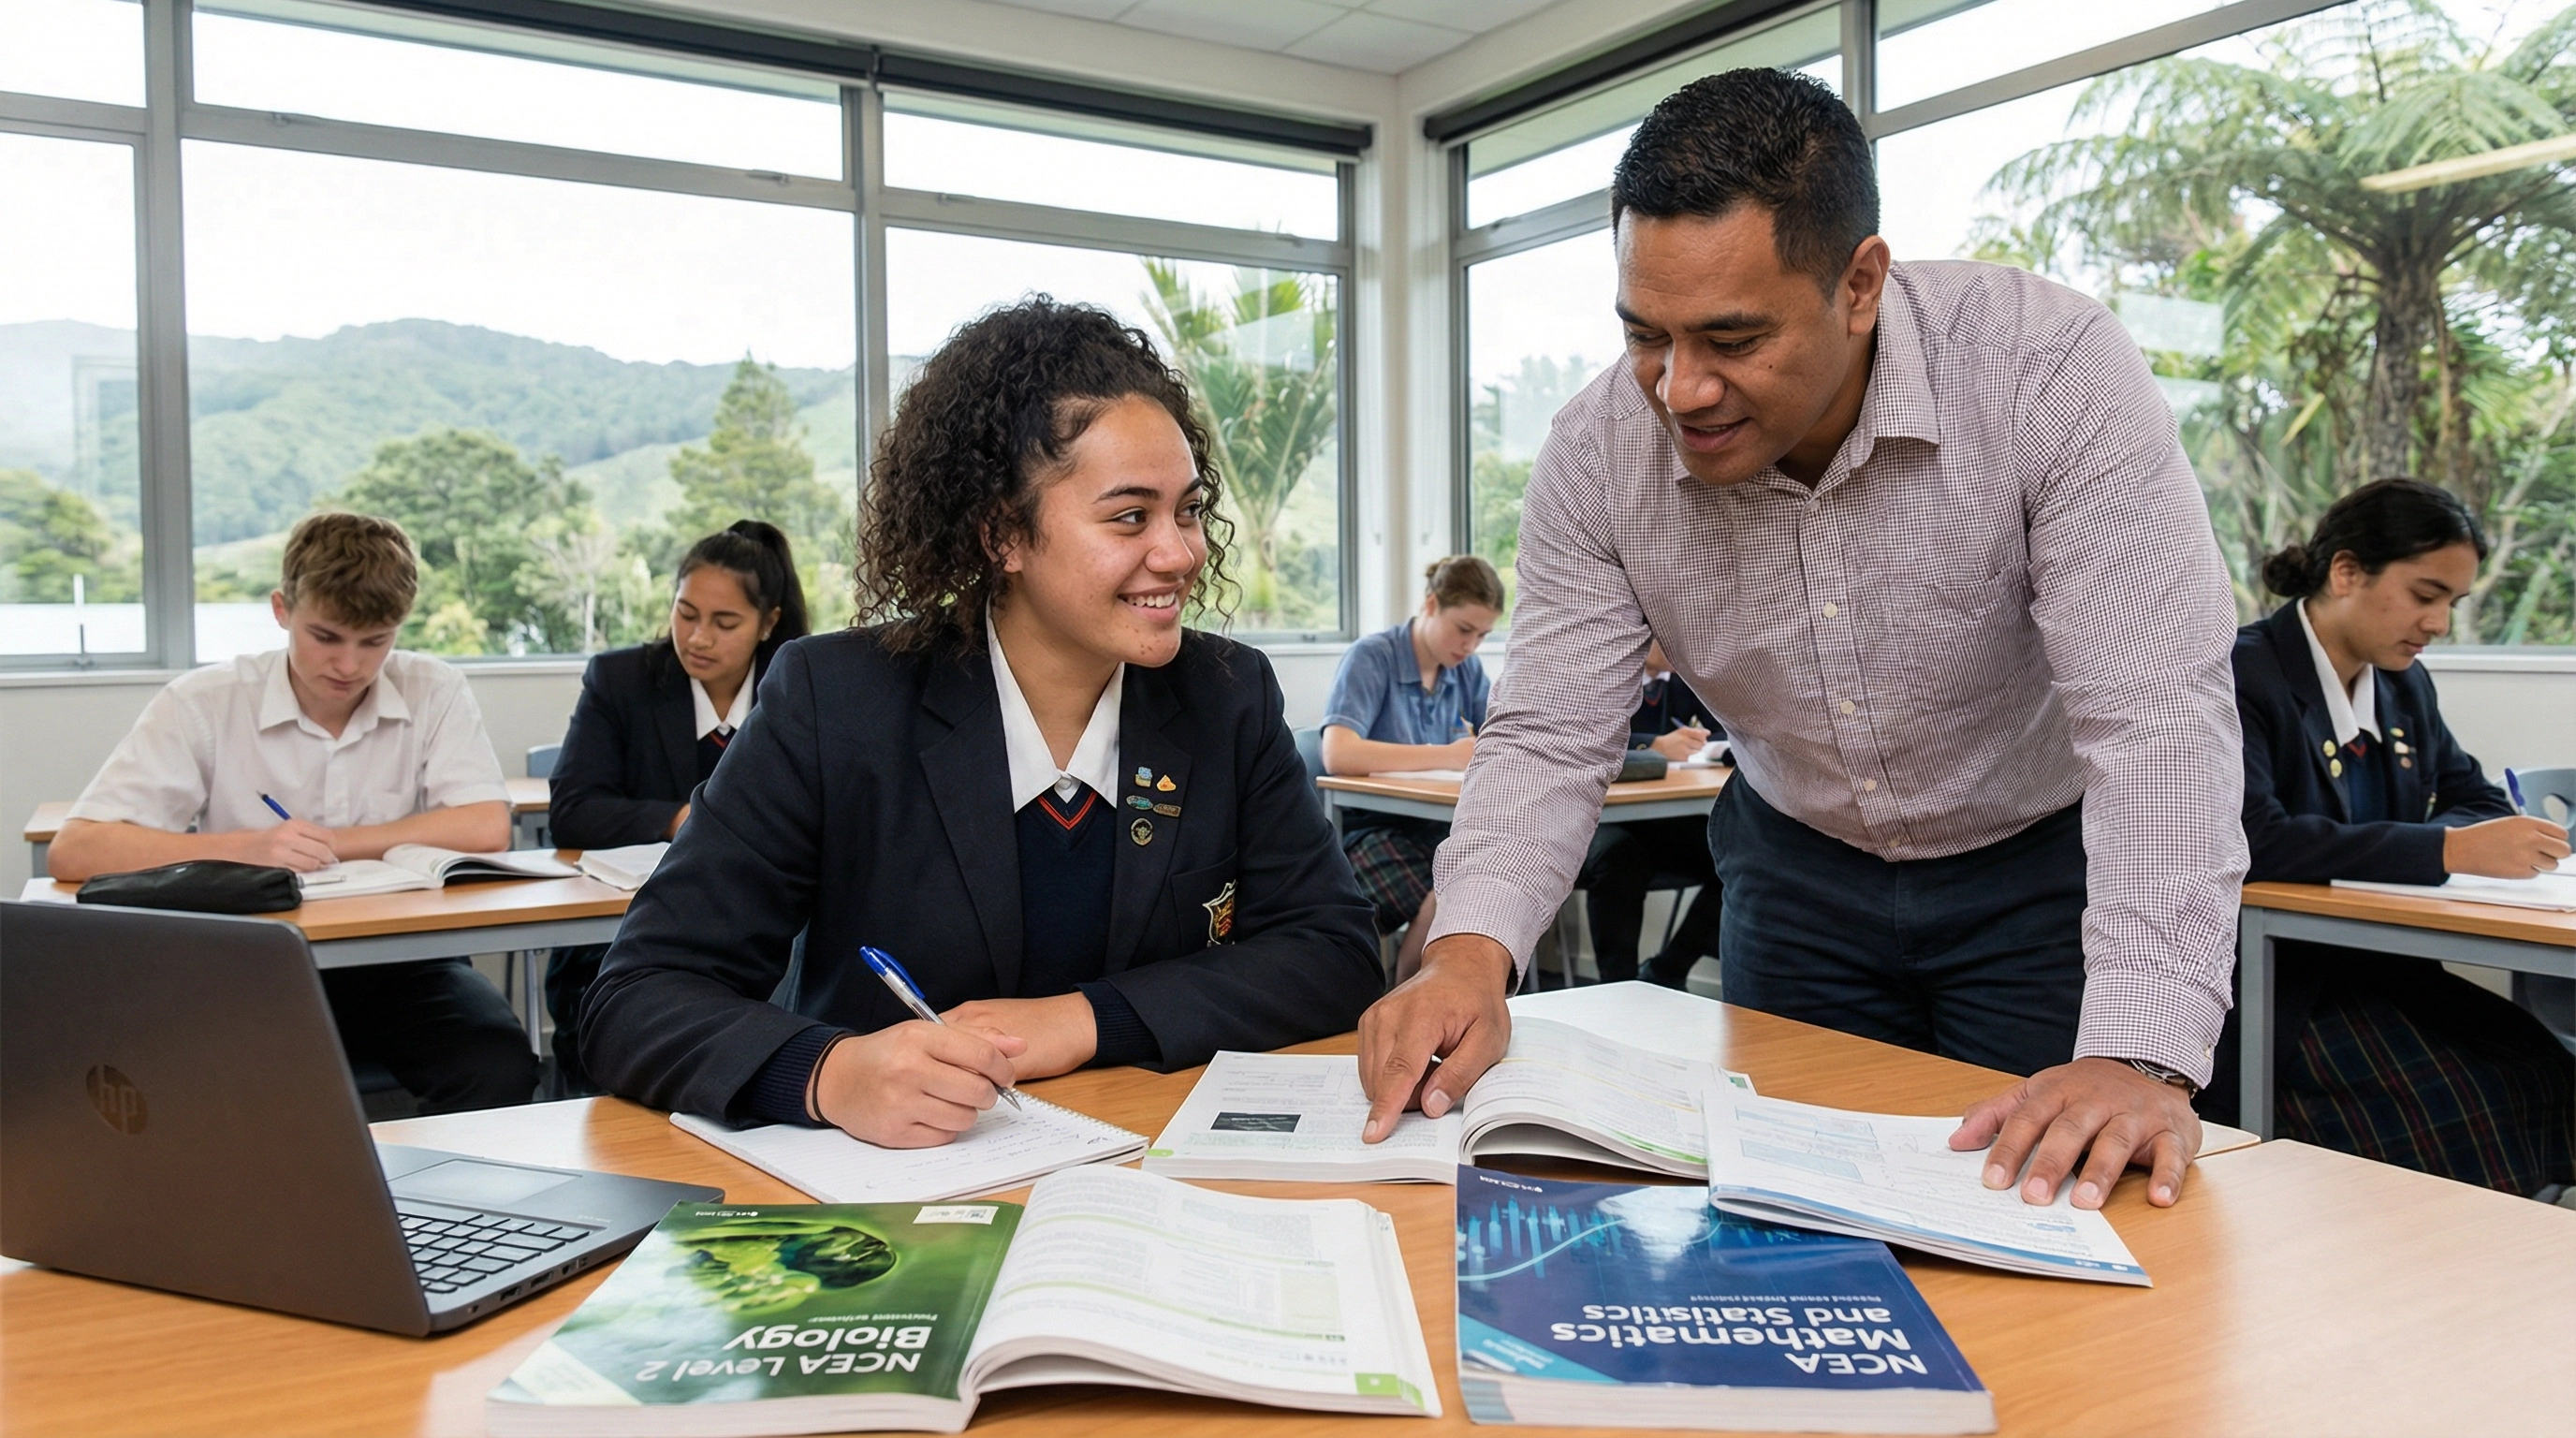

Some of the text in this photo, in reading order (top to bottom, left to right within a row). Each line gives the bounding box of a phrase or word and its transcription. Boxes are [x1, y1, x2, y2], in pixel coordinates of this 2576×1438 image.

[95, 1064, 139, 1133] hp
[1803, 1307, 1893, 1328] and
[721, 1324, 933, 1353] Biology
[1550, 1322, 1912, 1351] Mathematics
[635, 1352, 922, 1383] NCEA Level 2
[1783, 1352, 1929, 1375] NCEA
